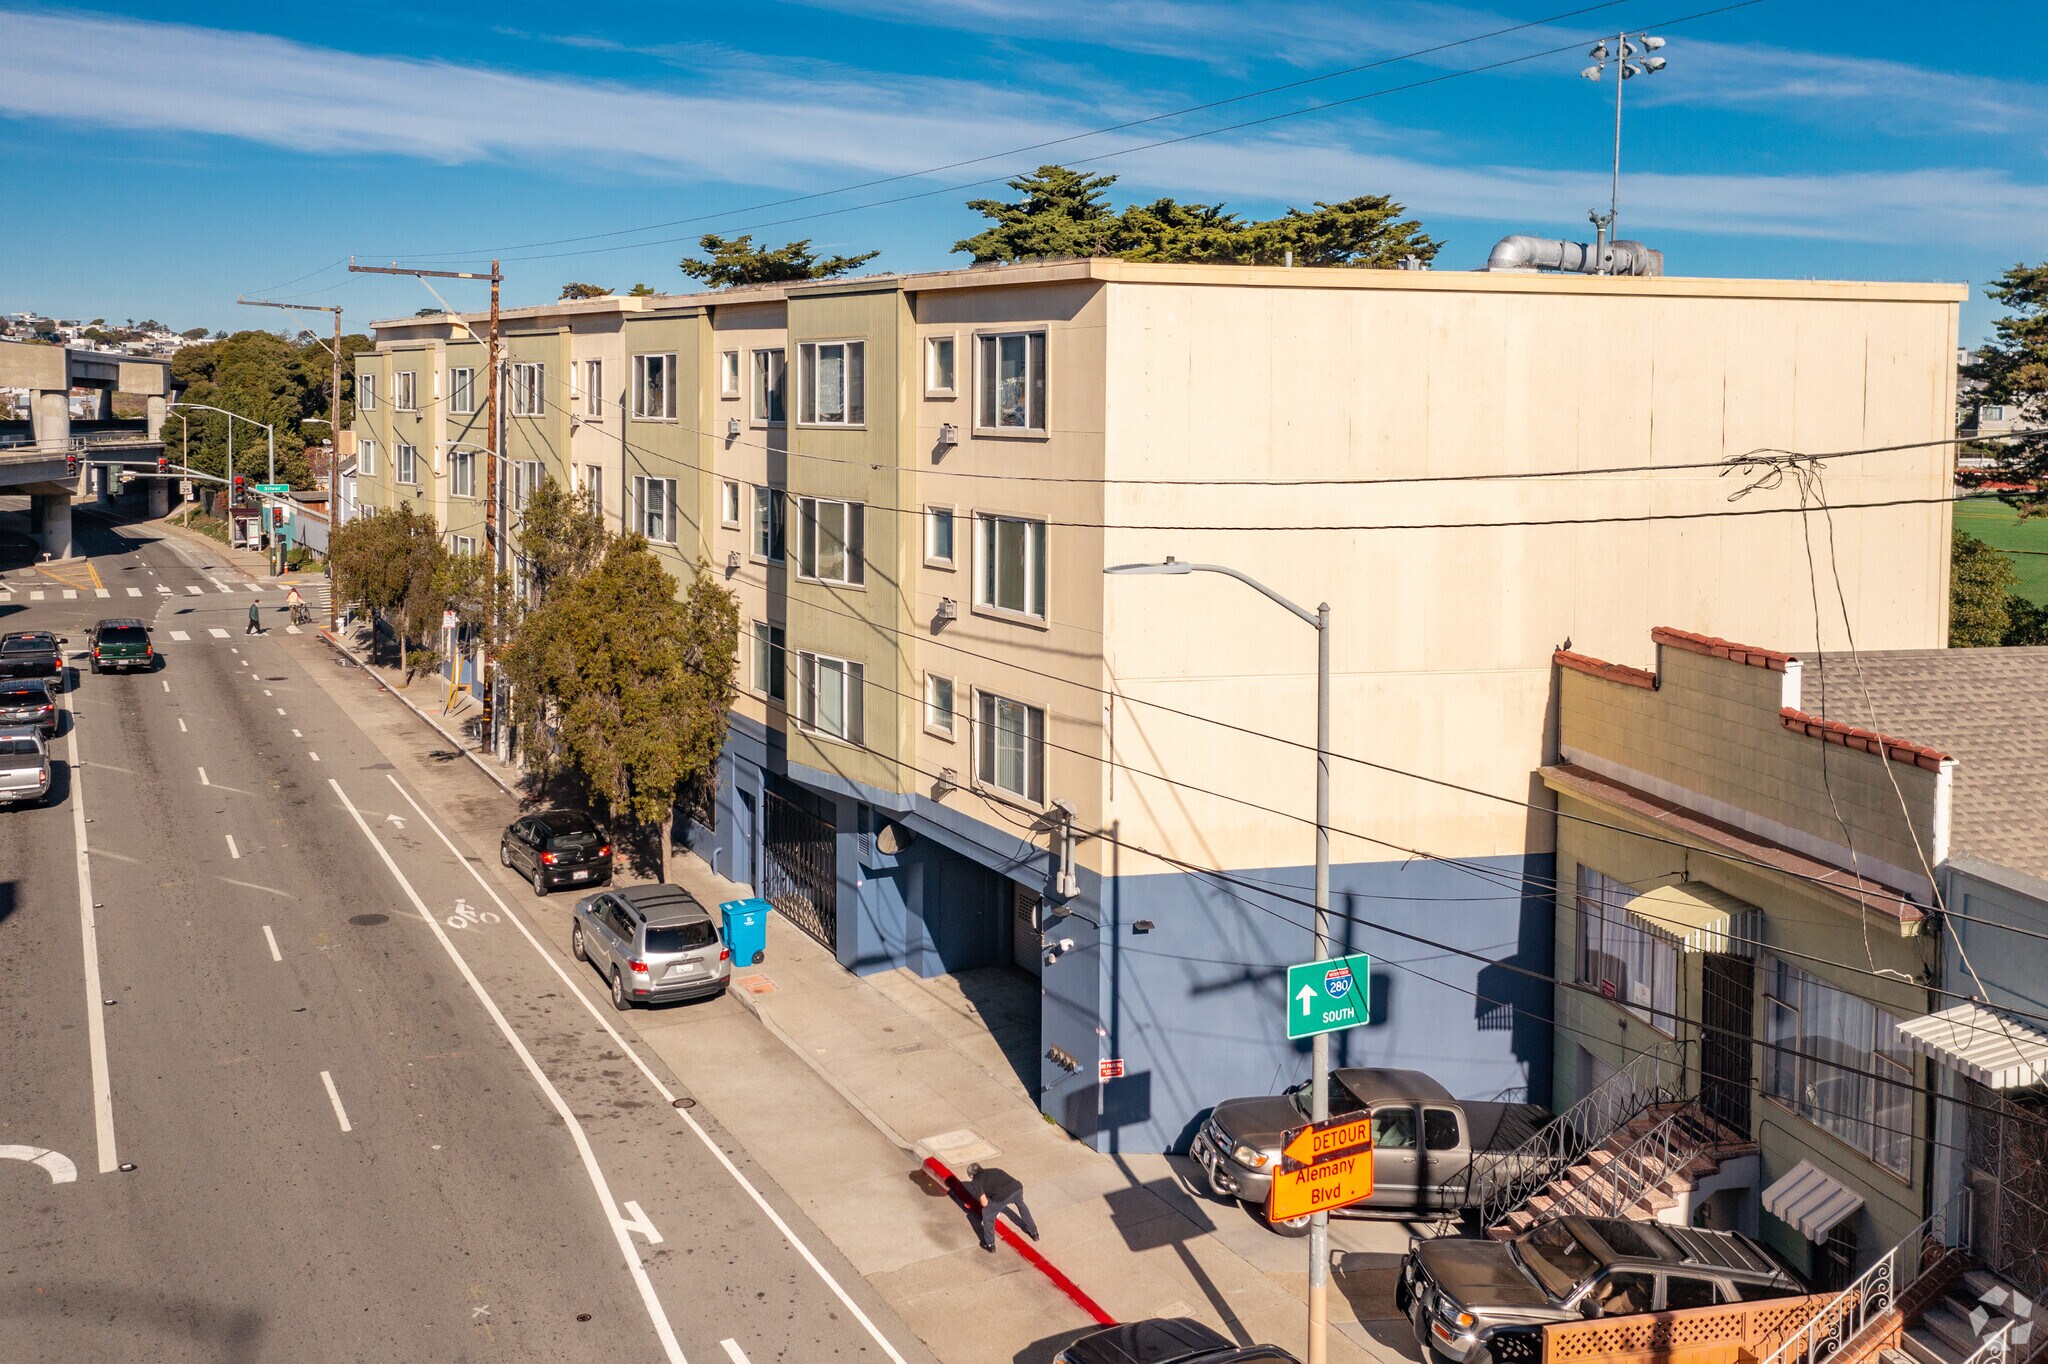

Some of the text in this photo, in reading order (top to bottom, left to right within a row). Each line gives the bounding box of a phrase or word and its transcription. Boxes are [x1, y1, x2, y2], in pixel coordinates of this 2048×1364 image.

[1330, 979, 1348, 993] 280
[1322, 1006, 1355, 1024] SOUTH
[1313, 1124, 1366, 1152] DETOUR
[1296, 1158, 1355, 1185] Alemany
[1312, 1182, 1341, 1205] Blvd
